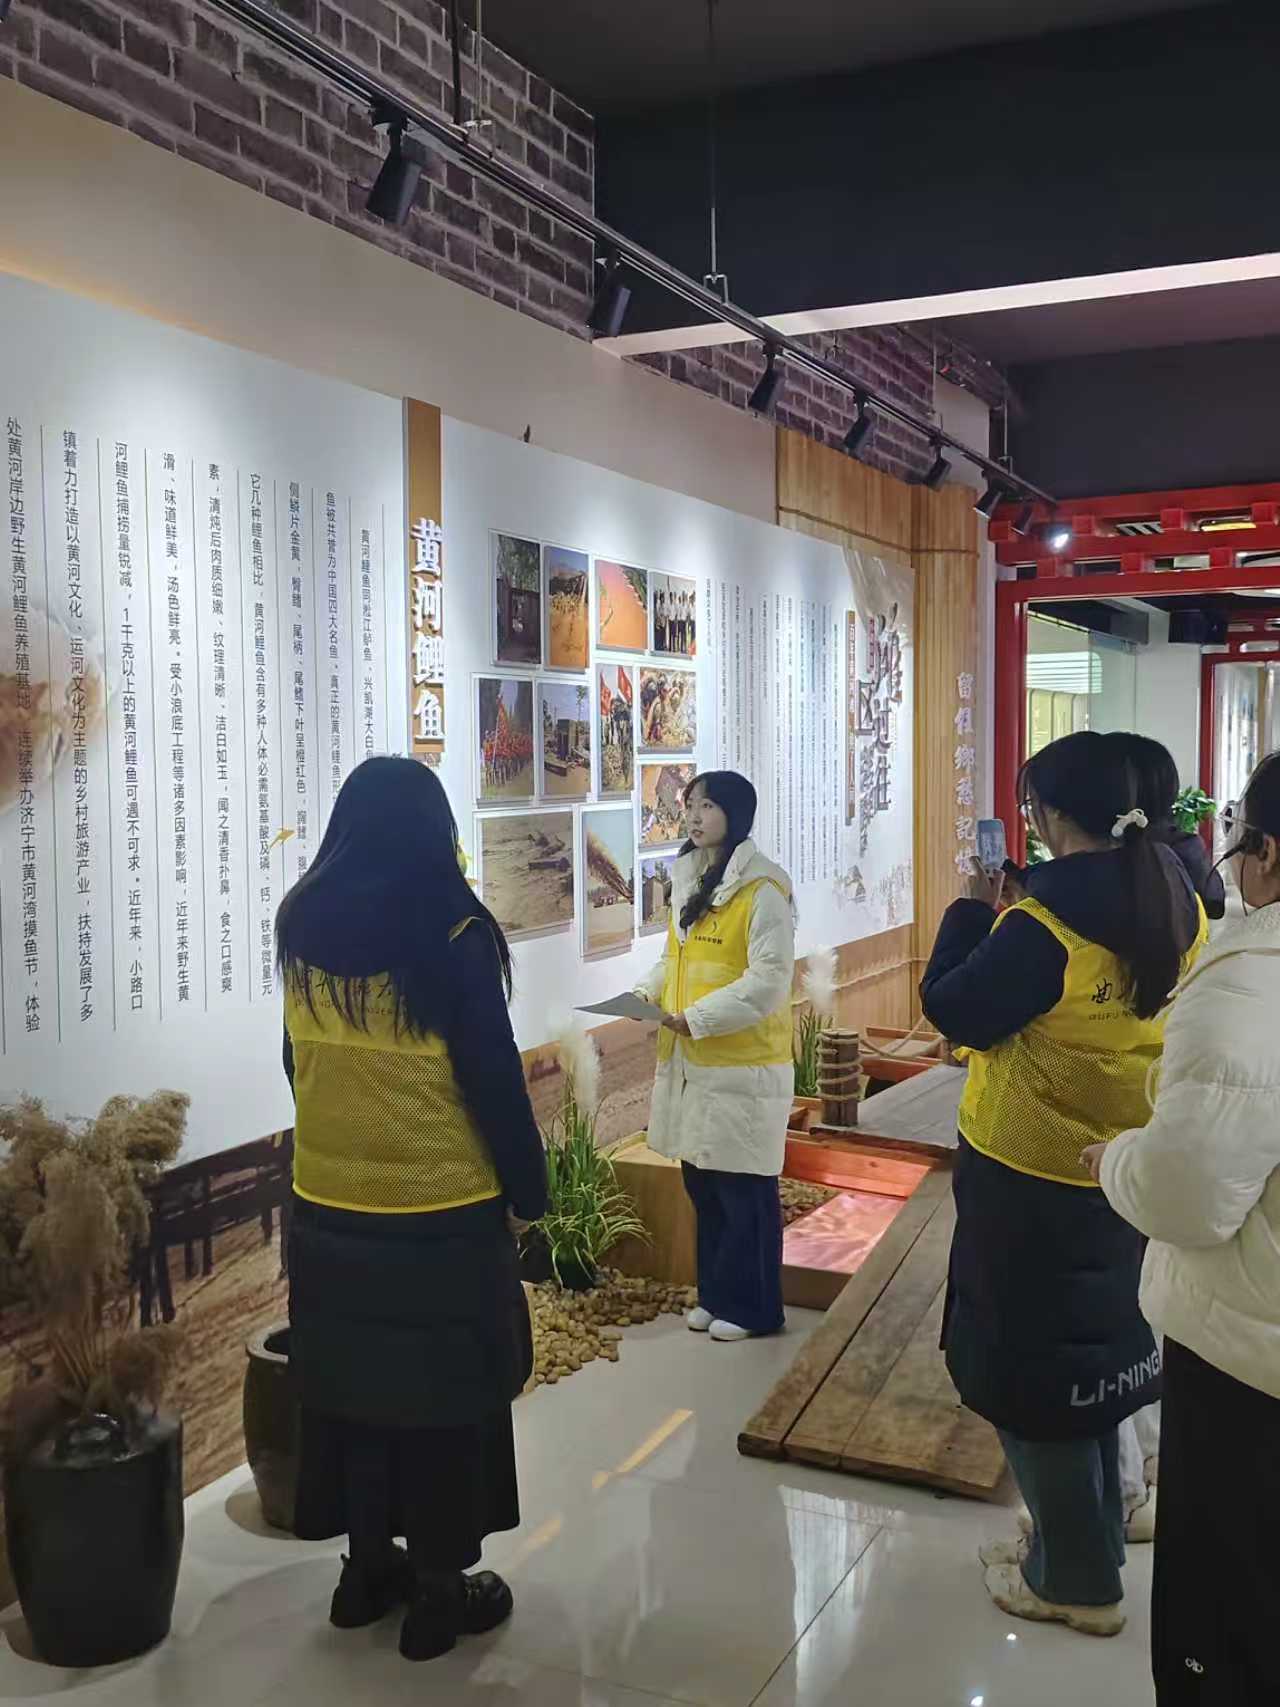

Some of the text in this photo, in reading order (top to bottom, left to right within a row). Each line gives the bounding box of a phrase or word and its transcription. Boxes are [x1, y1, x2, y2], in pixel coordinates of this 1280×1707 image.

[6, 416, 41, 1033] 处黄河岸边野生黄河鲤鱼养殖基地连续举办济宁市黄河湾摸鱼节，体验
[410, 517, 445, 741] 黄河鲤鱼
[1070, 1350, 1161, 1407] LI-NING
